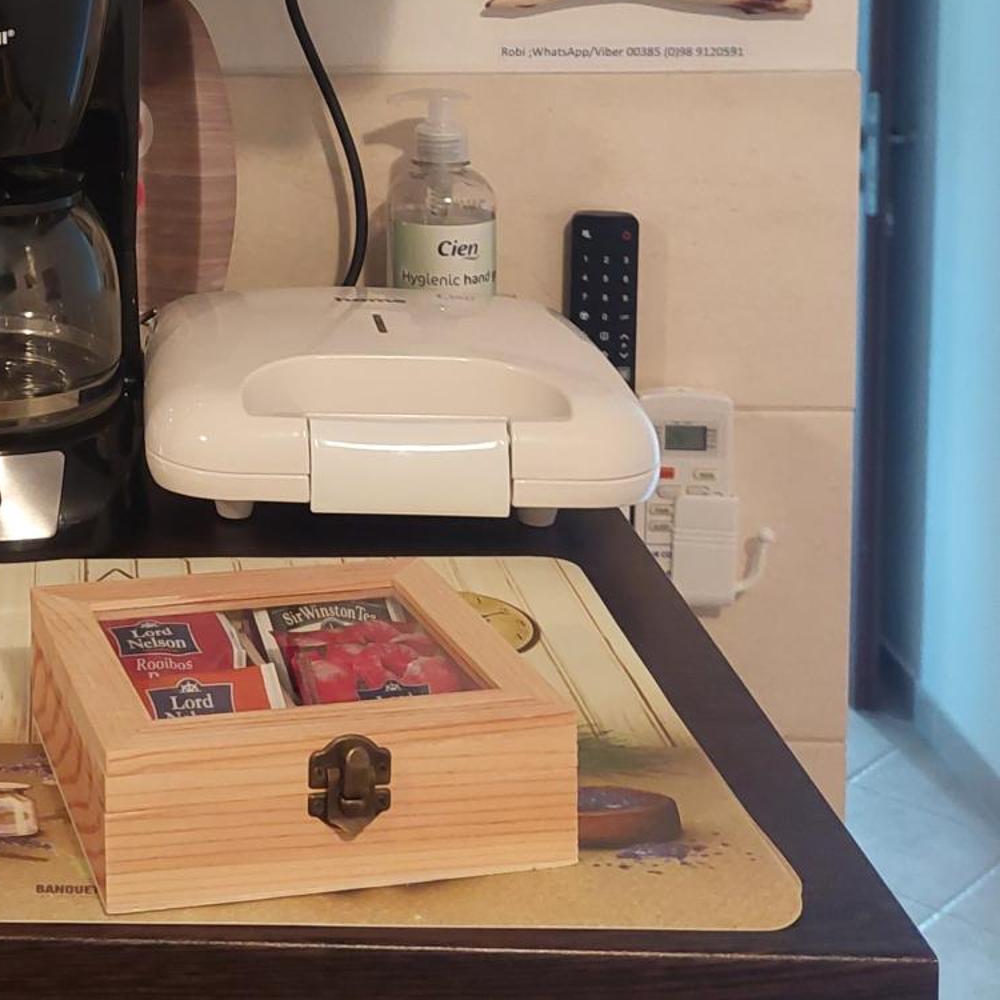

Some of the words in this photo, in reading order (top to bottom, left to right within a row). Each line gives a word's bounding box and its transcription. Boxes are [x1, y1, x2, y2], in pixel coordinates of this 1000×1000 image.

[501, 46, 526, 57] Robi
[437, 239, 480, 257] Cien
[402, 269, 460, 287] Hygienic
[463, 269, 491, 286] hand
[282, 609, 303, 626] Sir
[300, 604, 357, 621] Winston
[130, 626, 174, 639] Lord
[126, 638, 188, 651] Nelson
[136, 658, 194, 671] Rooibos
[169, 693, 215, 711] Lord
